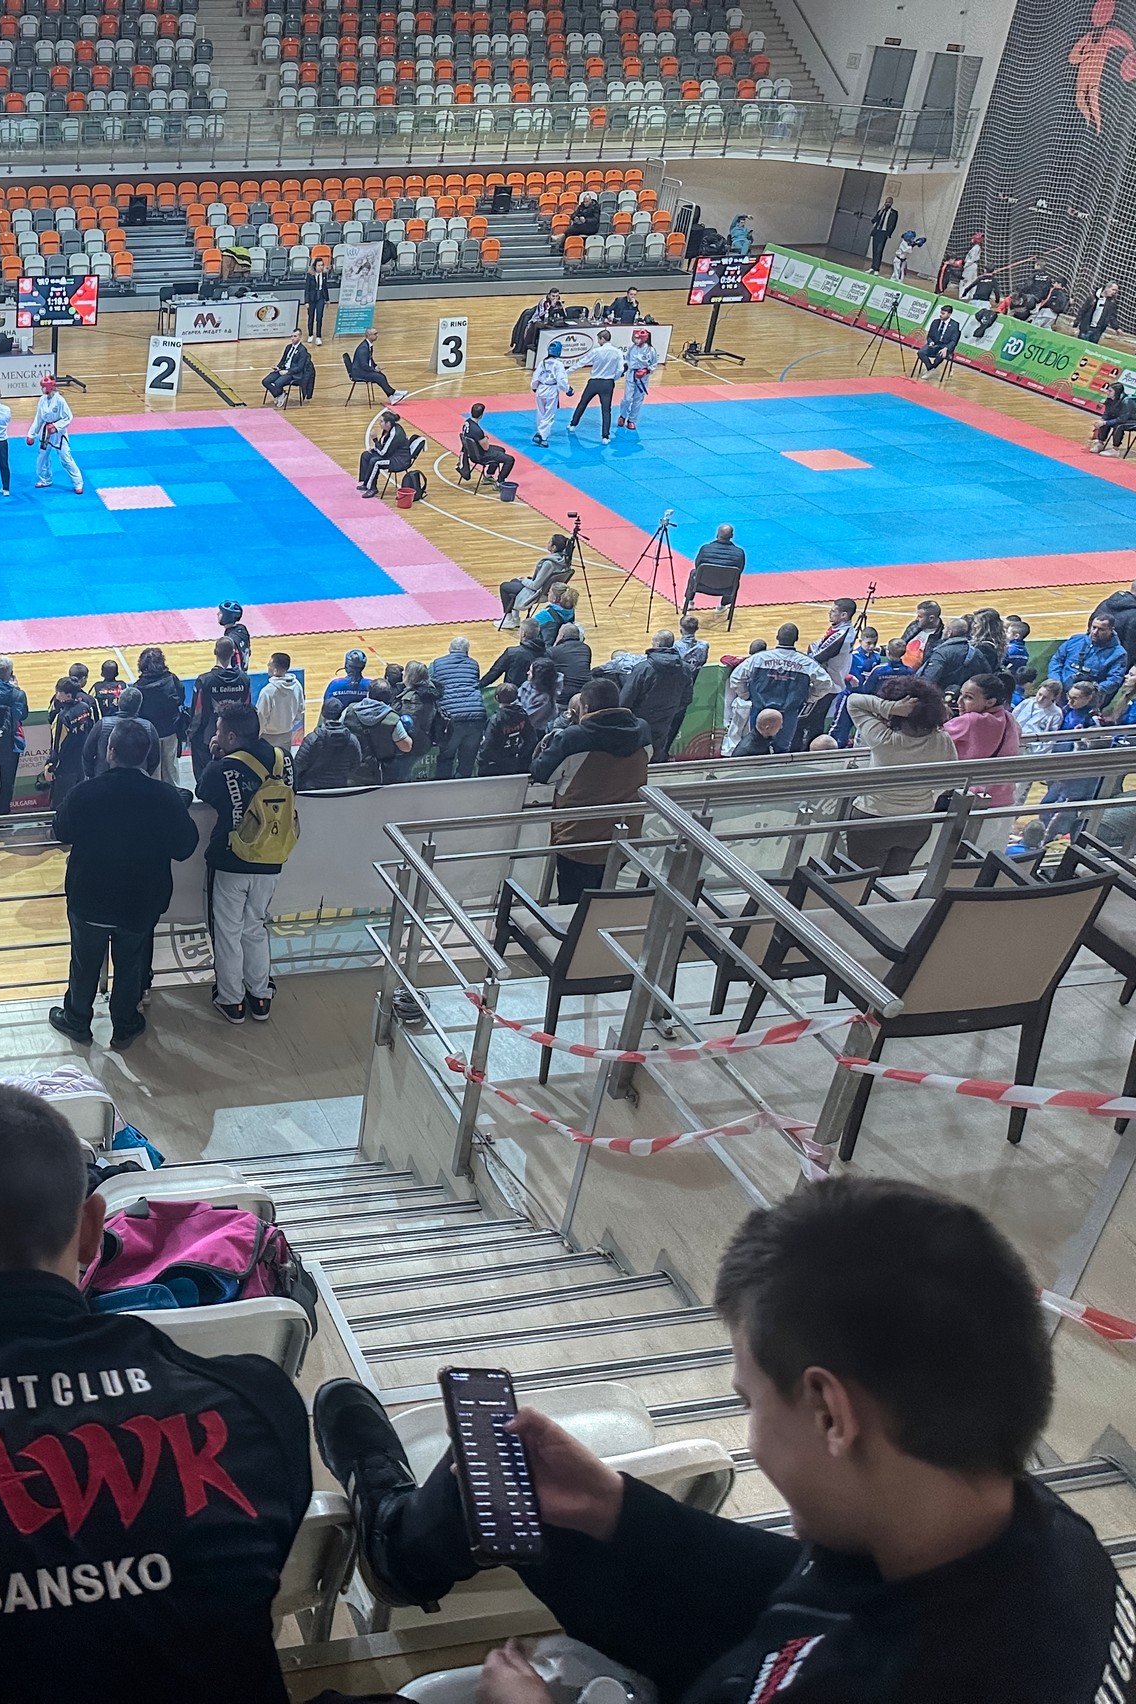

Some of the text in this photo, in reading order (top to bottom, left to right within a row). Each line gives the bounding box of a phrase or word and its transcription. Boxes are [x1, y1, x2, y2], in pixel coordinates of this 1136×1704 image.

[450, 320, 467, 328] RING
[162, 340, 182, 348] RING
[441, 335, 463, 367] 3
[1024, 344, 1070, 371] STUDIO
[149, 356, 176, 390] 2
[51, 1367, 152, 1406] CLUB
